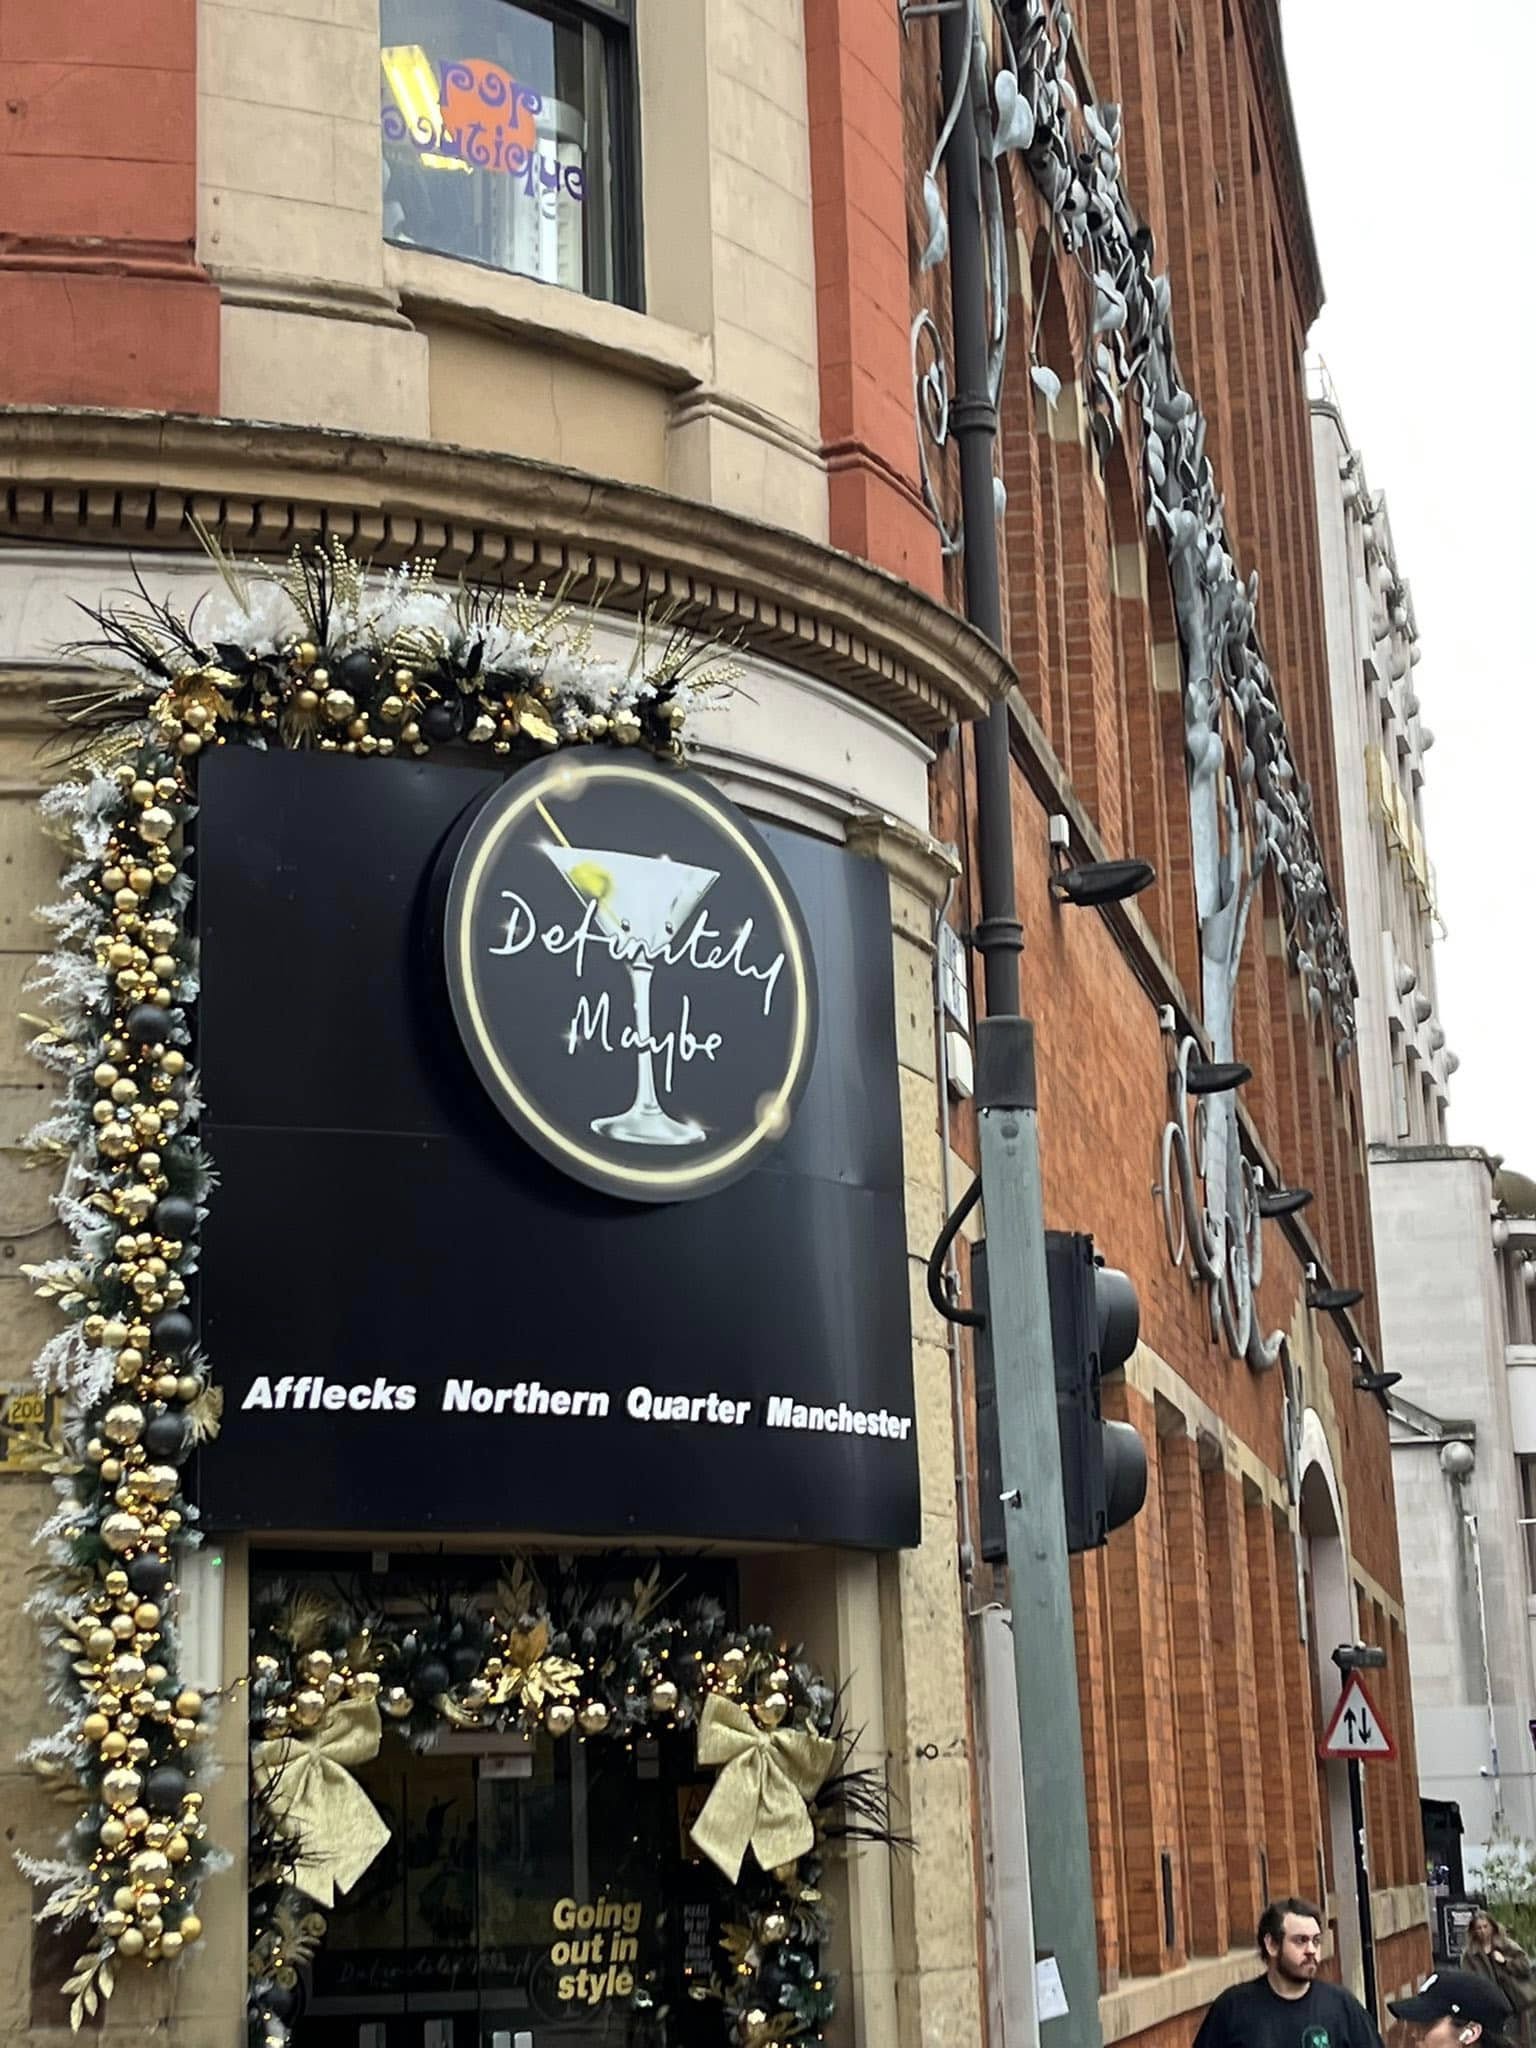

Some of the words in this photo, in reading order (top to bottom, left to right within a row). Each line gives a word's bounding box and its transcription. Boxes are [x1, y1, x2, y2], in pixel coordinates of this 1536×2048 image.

[489, 891, 785, 1015] Definitely
[568, 991, 723, 1092] Maybe
[12, 1401, 43, 1418] 200
[241, 1376, 417, 1411] Afflecks
[441, 1379, 610, 1417] Northern
[625, 1386, 752, 1425] Quarter
[766, 1396, 912, 1440] Manchester
[553, 1897, 641, 1933] Going
[551, 1933, 605, 1966] out
[610, 1931, 638, 1962] in
[558, 1964, 634, 2005] style
